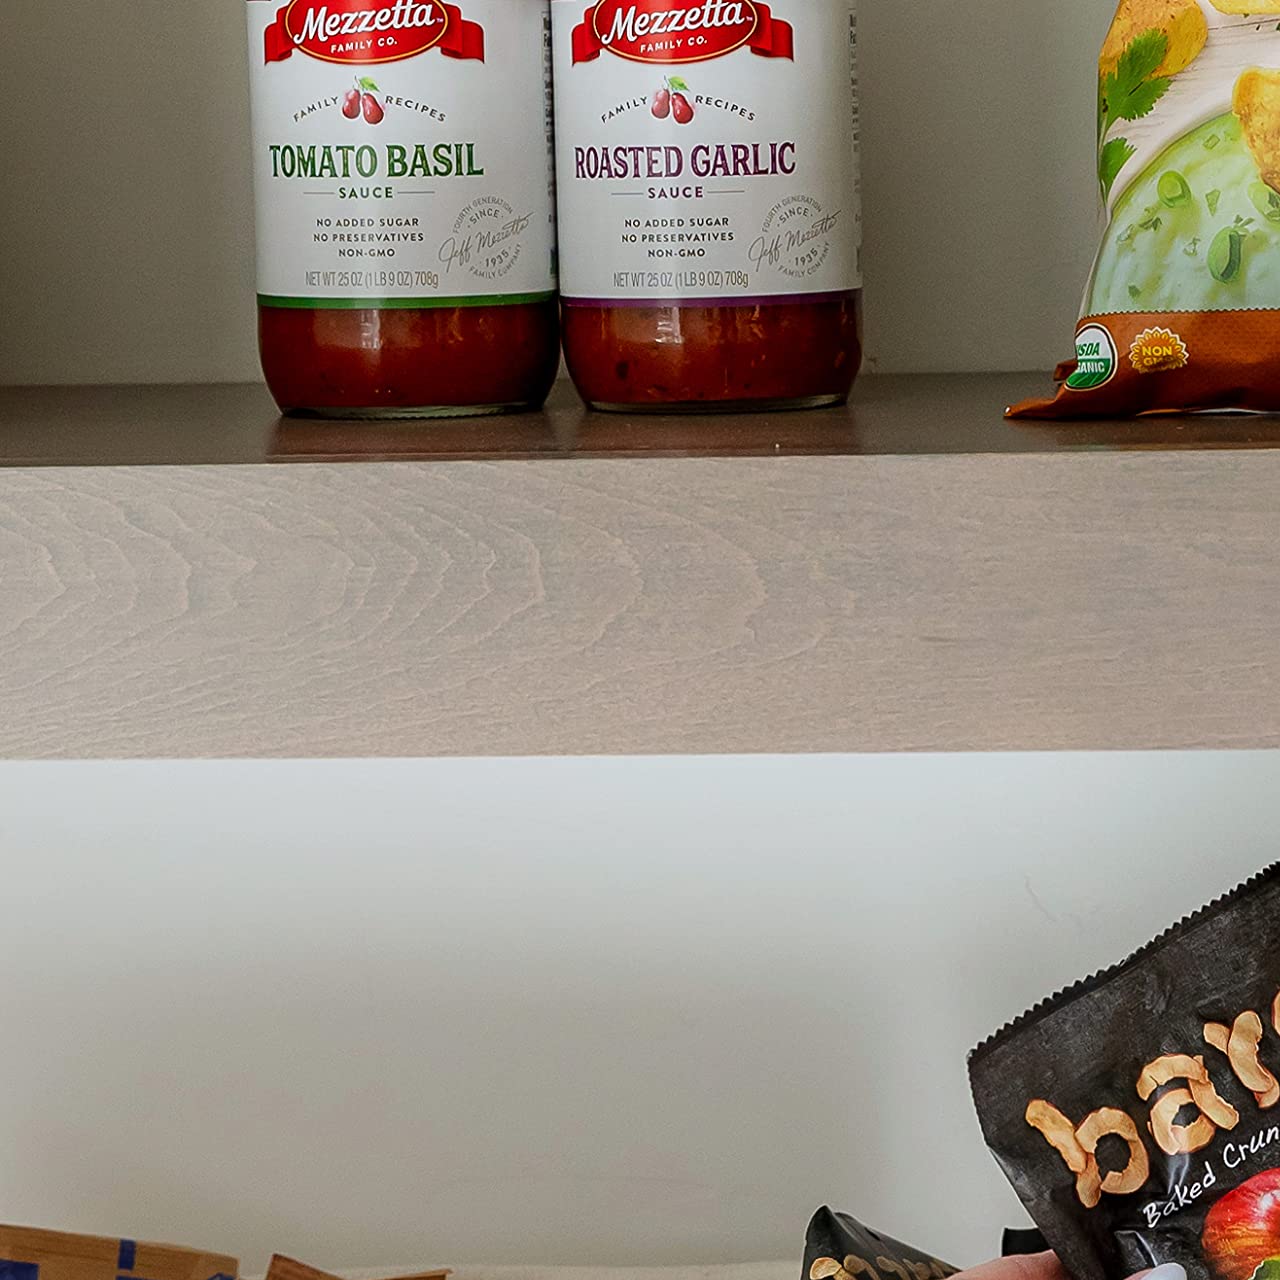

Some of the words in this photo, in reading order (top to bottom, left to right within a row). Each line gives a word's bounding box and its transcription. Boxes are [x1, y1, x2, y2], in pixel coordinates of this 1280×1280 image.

[294, 0, 435, 44] Mezzetta
[600, 0, 745, 45] Mezzetta
[331, 40, 373, 53] FAMILY
[377, 39, 398, 48] CO.
[640, 39, 683, 53] FAMILY
[687, 38, 708, 47] CO.
[293, 96, 339, 123] FAMILY
[385, 95, 447, 123] RECIPES
[601, 96, 648, 123] FAMILY
[694, 95, 756, 122] RECIPES
[269, 144, 378, 178] TOMATO
[385, 143, 485, 177] BASIL
[574, 146, 684, 179] ROASTED
[690, 142, 797, 178] GARLIC
[339, 187, 393, 199] SAUCE
[648, 186, 703, 199] SAUCE
[316, 218, 332, 228] NO
[336, 218, 375, 228] ADDED
[379, 217, 419, 228] SUGAR
[469, 208, 500, 225] SINCE
[624, 218, 641, 228] NO
[644, 217, 685, 228] ADDED
[689, 217, 729, 227] SUGAR
[778, 206, 809, 224] SINCE
[313, 233, 329, 243] NO
[332, 233, 424, 243] PRESERVATIVES
[621, 233, 637, 243] NO
[641, 232, 734, 243] PRESERVATIVES
[338, 248, 396, 258] NON-GMO
[438, 235, 472, 274] Jeff
[485, 248, 510, 268] 1935
[647, 248, 706, 258] NON-GMO
[748, 234, 783, 273] Jeff
[795, 247, 818, 266] 1935
[305, 272, 321, 286] NET
[322, 272, 337, 286] WT
[338, 272, 350, 287] 25
[350, 272, 363, 286] OZ
[373, 272, 387, 287] LB
[388, 272, 396, 286] 9
[397, 271, 414, 288] OZ)
[415, 271, 439, 288] 708g
[469, 265, 497, 280] FAMILY
[613, 273, 630, 287] NET
[631, 272, 646, 287] WT
[647, 272, 660, 287] 25
[660, 272, 673, 287] OZ
[683, 272, 697, 287] LB
[698, 272, 706, 287] 9
[707, 271, 724, 288] OZ)
[725, 271, 749, 288] 708g
[778, 265, 806, 278] FAMILY
[1142, 346, 1173, 356] NON
[1143, 1161, 1216, 1228] Baked
